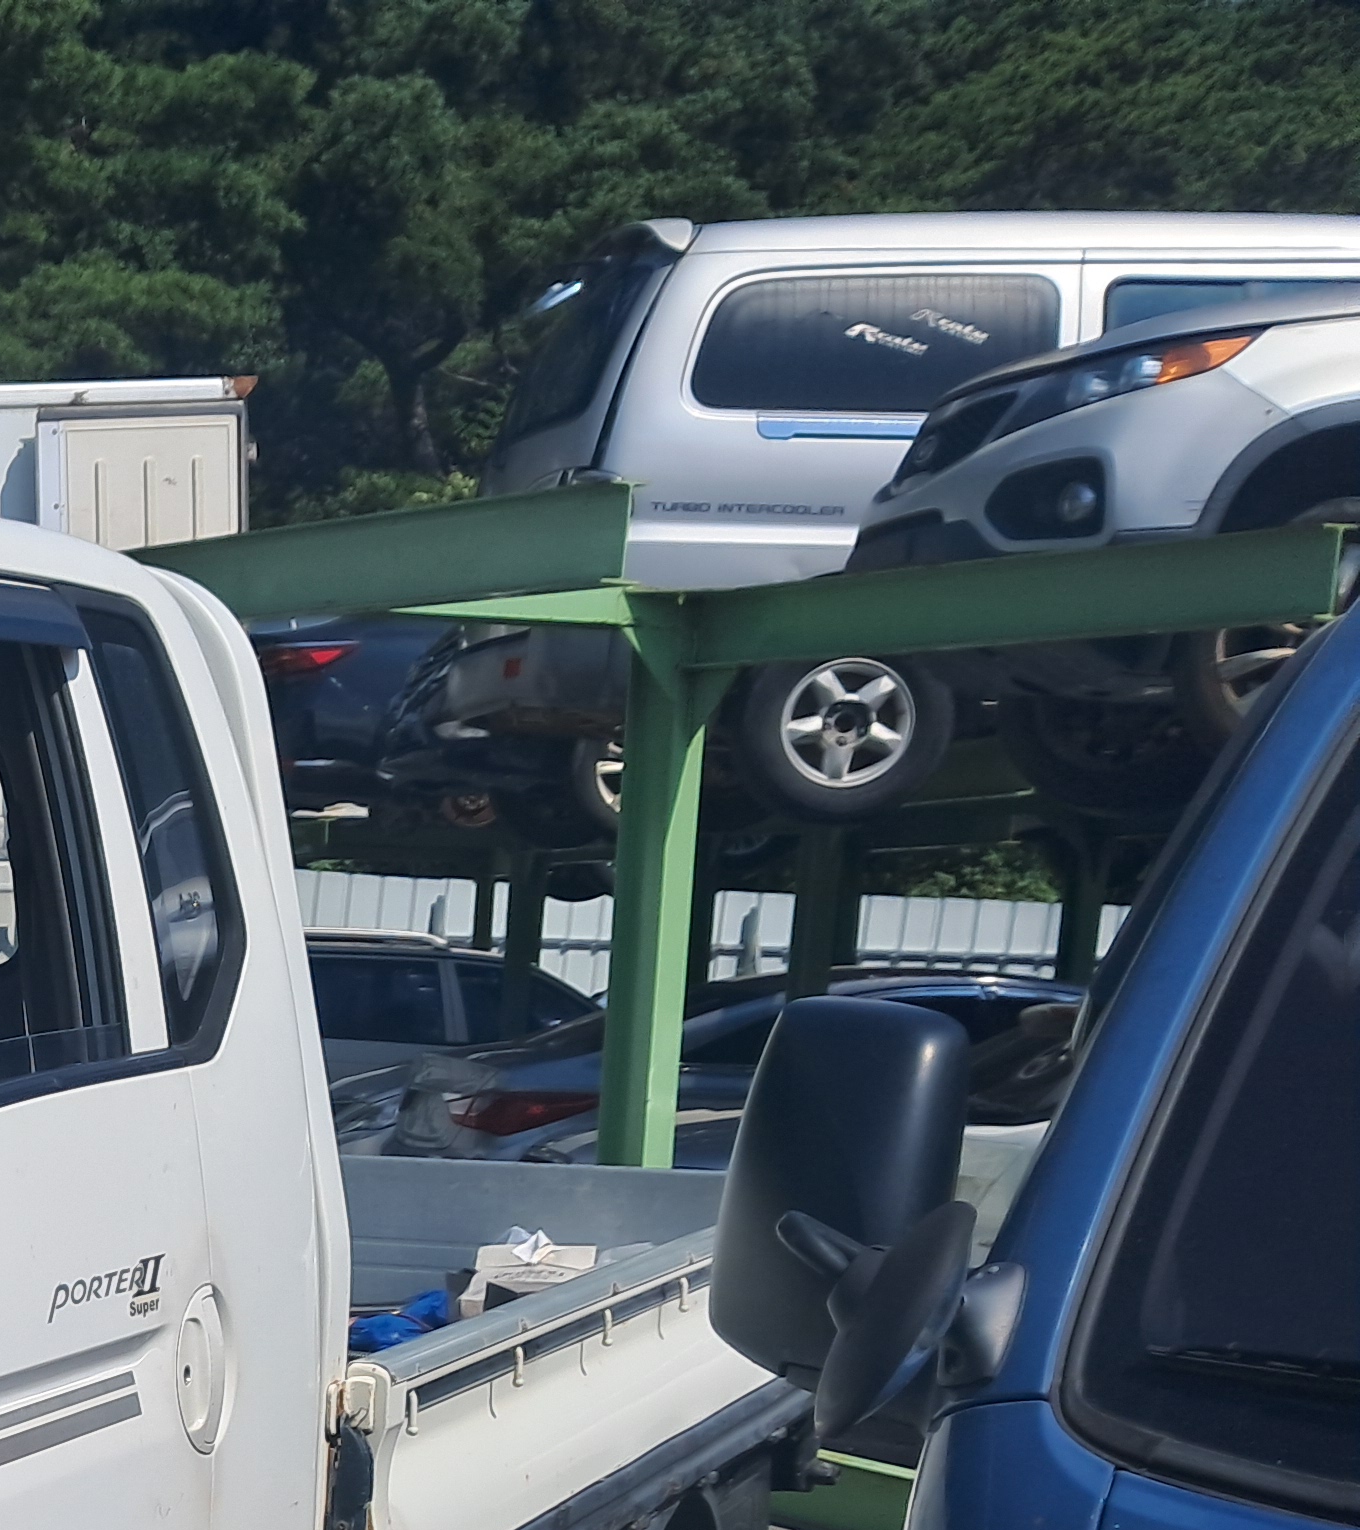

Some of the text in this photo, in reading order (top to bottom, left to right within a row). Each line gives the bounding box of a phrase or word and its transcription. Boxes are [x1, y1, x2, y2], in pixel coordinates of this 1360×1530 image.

[651, 501, 845, 517] TURBO INTERCOOLER
[129, 1297, 160, 1318] Super
